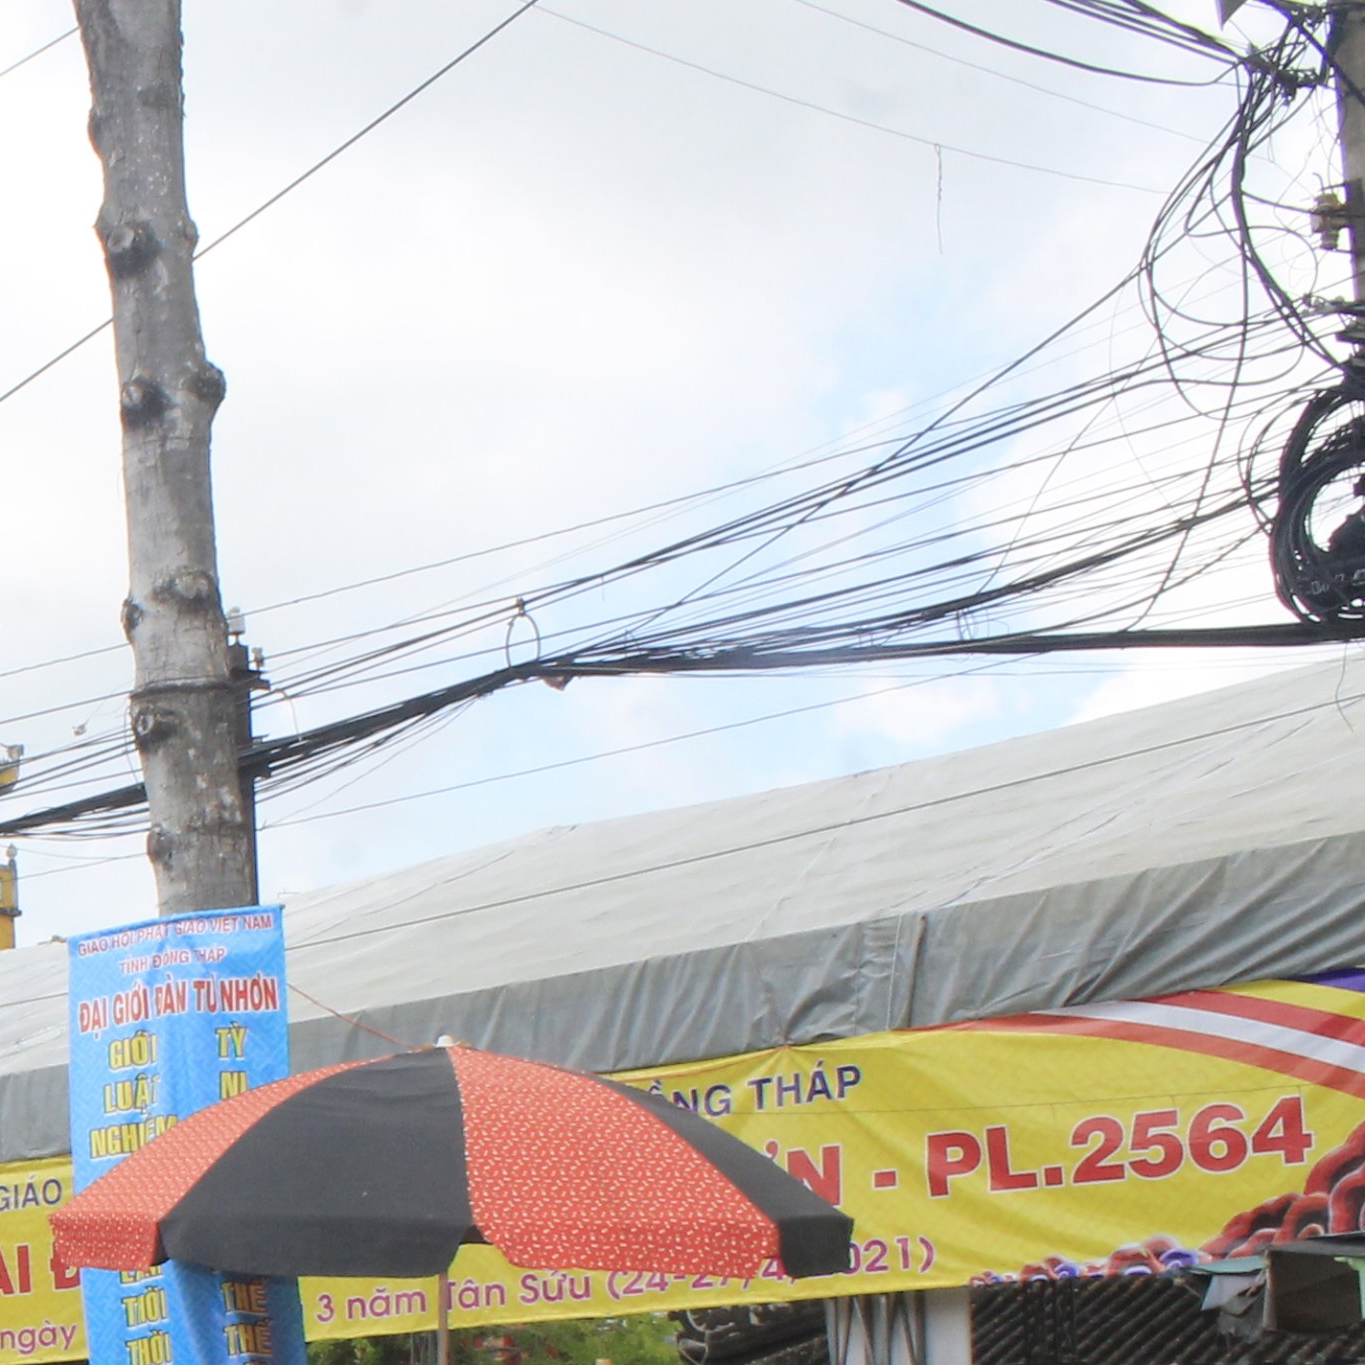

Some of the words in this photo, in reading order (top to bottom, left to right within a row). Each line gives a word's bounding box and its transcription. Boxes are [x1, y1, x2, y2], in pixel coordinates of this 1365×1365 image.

[244, 913, 273, 930] NAM
[79, 1000, 108, 1039] ĐẠI
[112, 981, 150, 1026] GIỚI
[155, 974, 187, 1017] ĐÀN
[219, 973, 278, 1013] NHƠN
[109, 1028, 159, 1071] GIỚI
[748, 1060, 862, 1111] THÁP
[926, 1094, 1314, 1199] PL.2564
[316, 1293, 335, 1323] 3
[346, 1287, 427, 1321] năm
